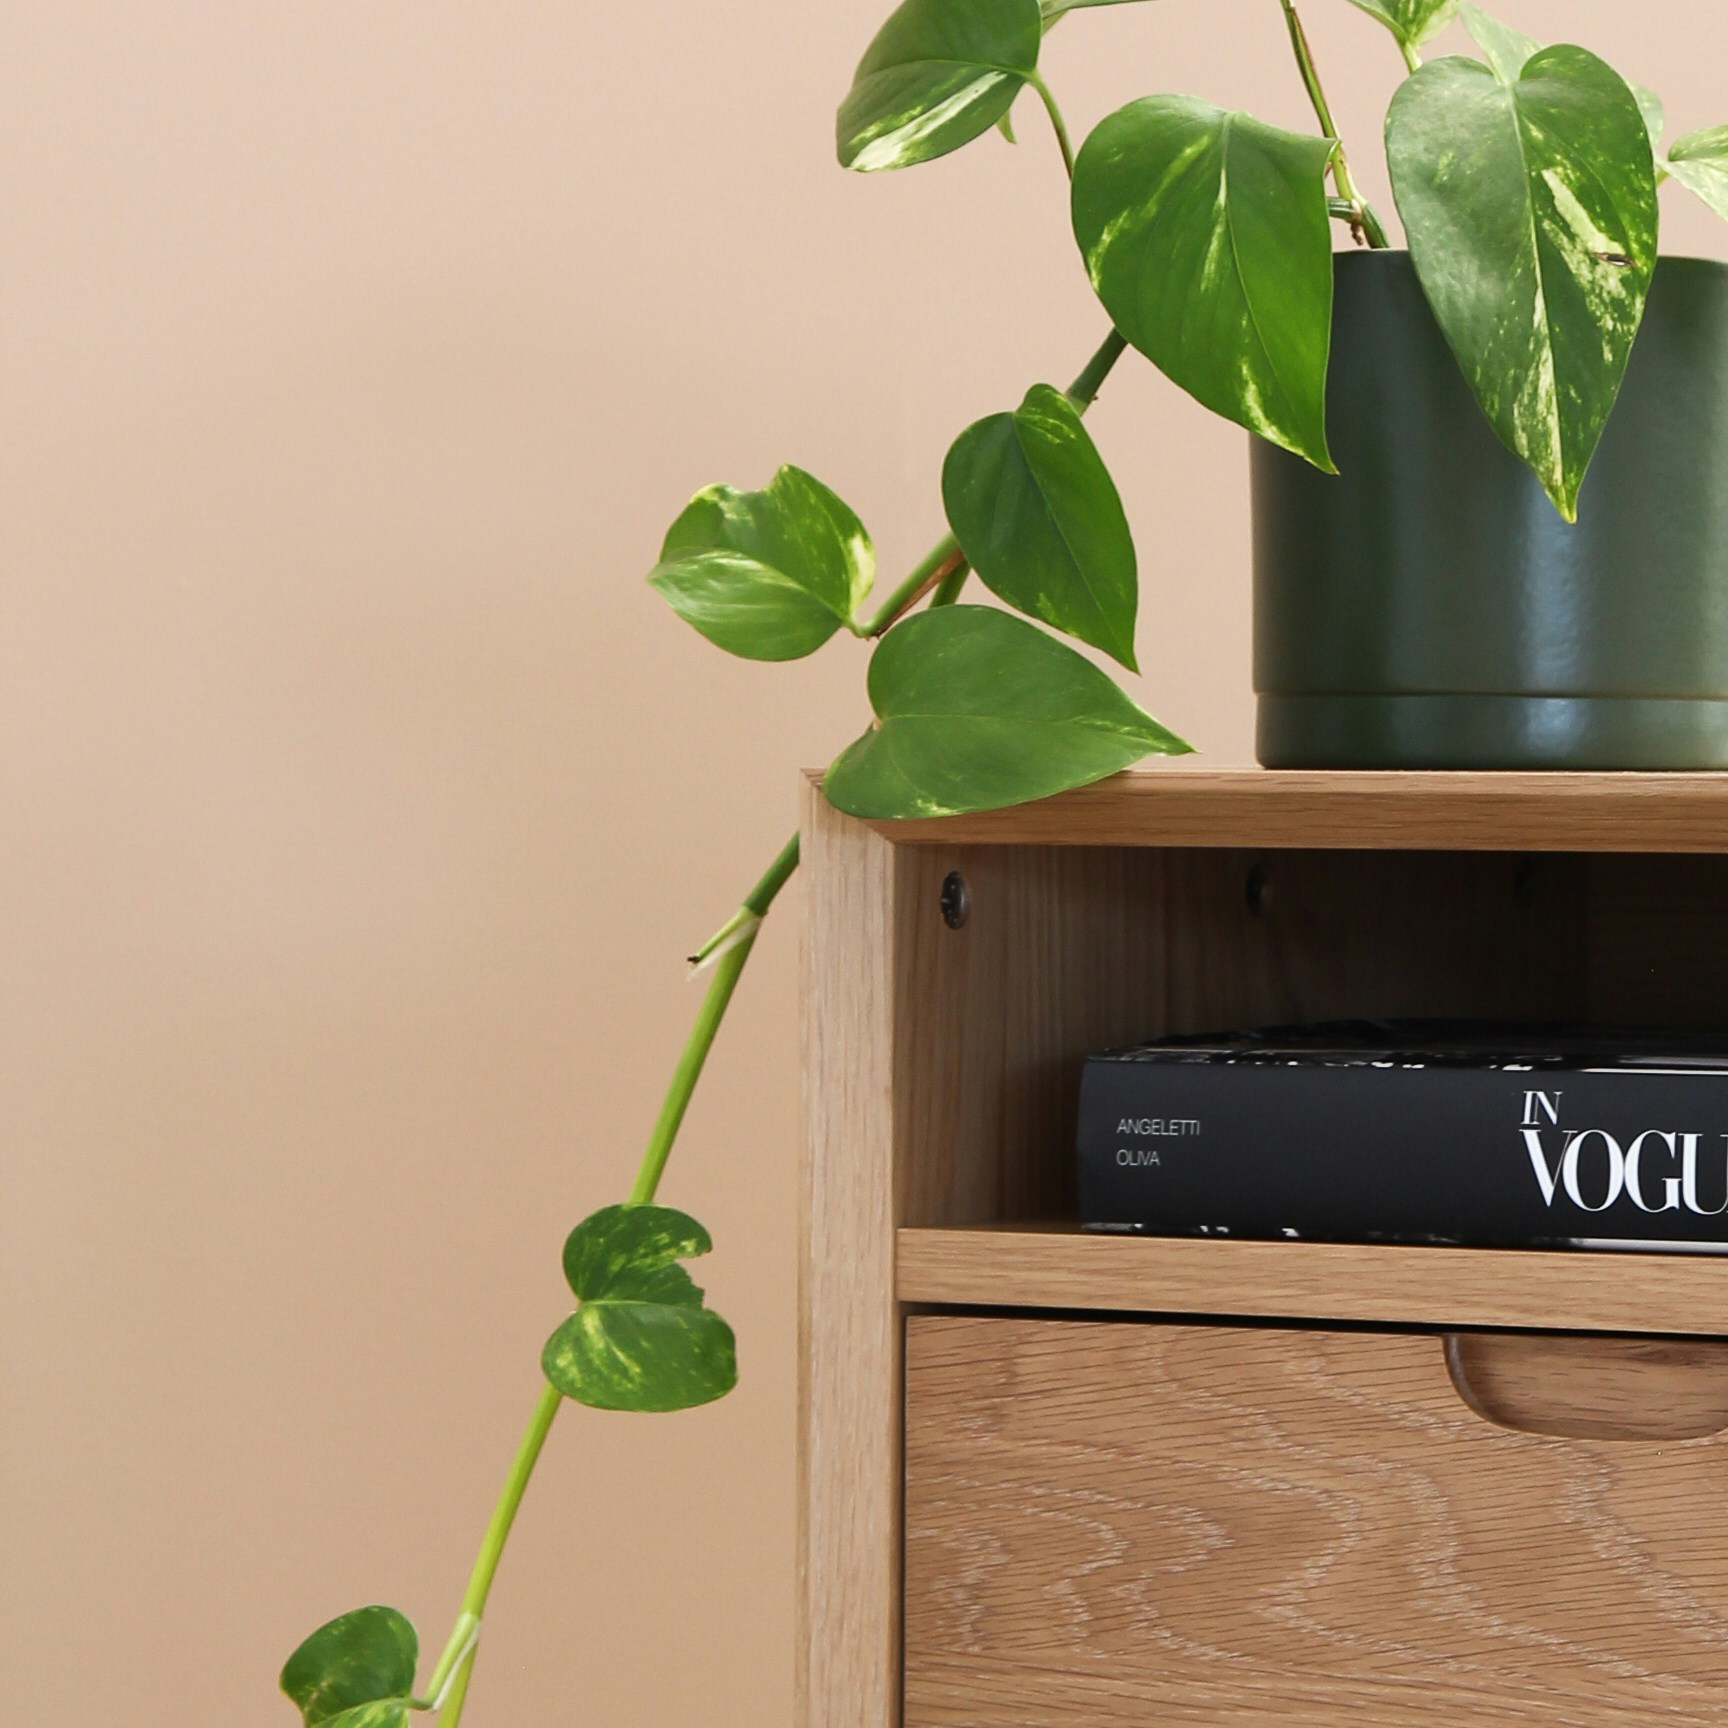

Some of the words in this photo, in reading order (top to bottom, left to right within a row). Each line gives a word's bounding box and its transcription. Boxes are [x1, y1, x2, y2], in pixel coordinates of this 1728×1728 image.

[1520, 1090, 1563, 1125] IN
[1116, 1119, 1200, 1136] ANGELETTI
[1116, 1149, 1160, 1166] OLIVA
